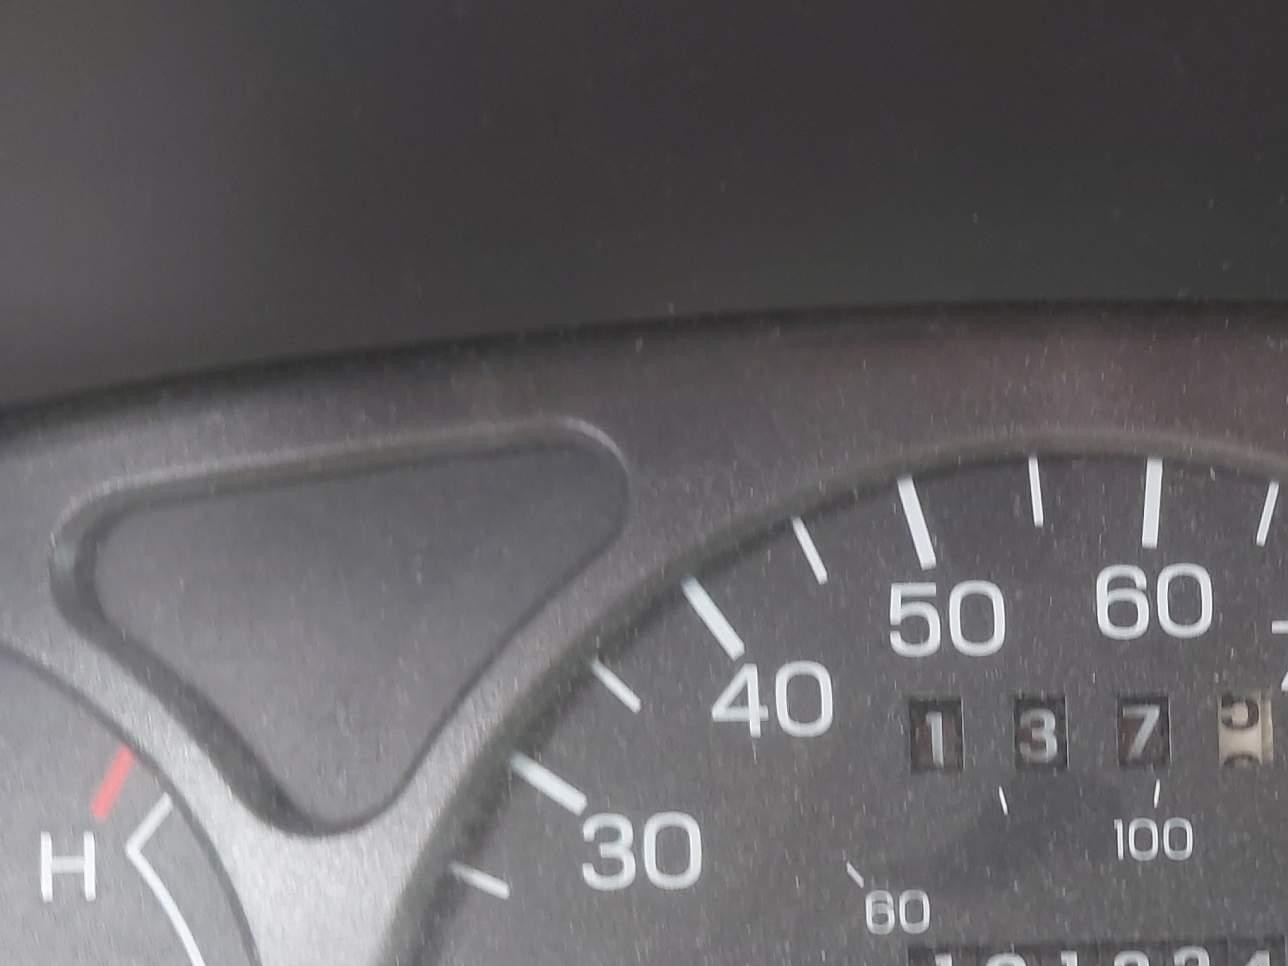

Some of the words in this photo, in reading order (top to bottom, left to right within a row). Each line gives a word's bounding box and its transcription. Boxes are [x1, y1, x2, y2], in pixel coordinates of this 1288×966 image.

[889, 580, 1006, 658] 50
[1095, 563, 1213, 640] 60
[711, 661, 834, 738] 40
[40, 832, 96, 902] H
[581, 812, 703, 891] 30
[1113, 817, 1194, 861] 100
[864, 890, 931, 935] 60
